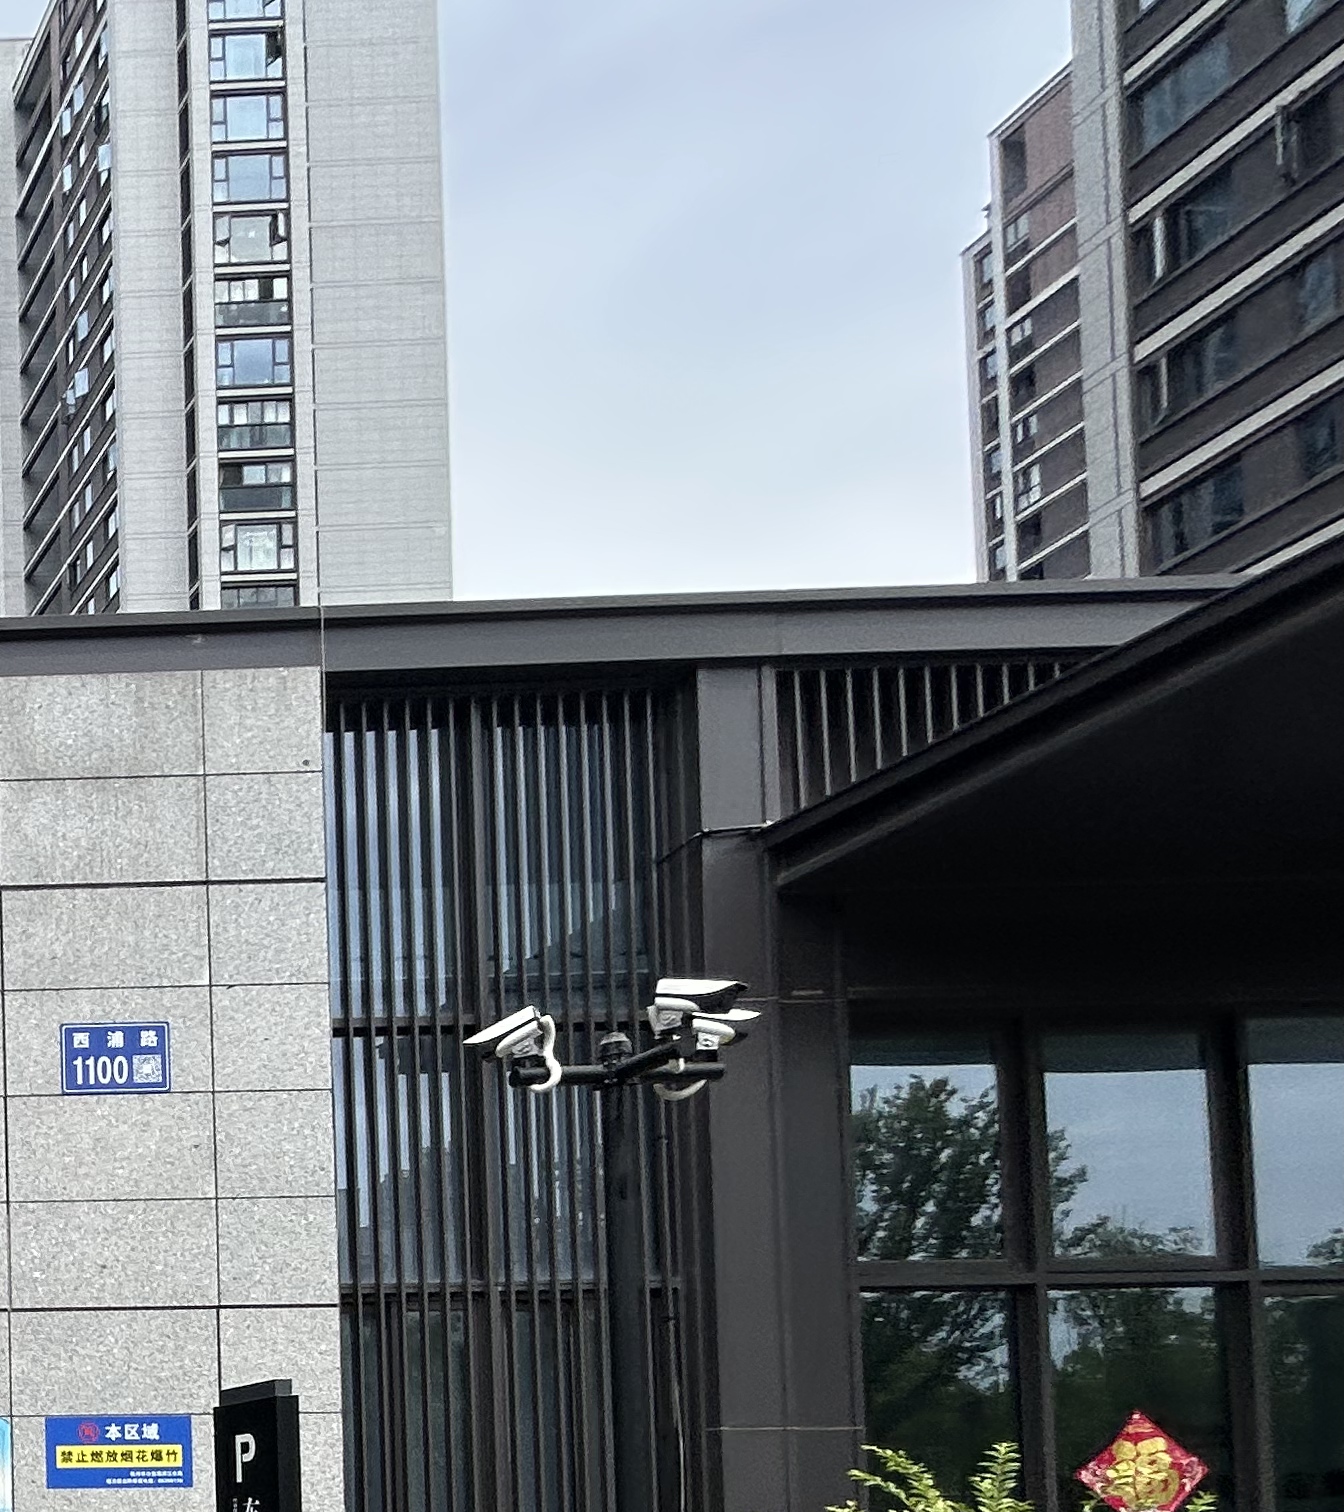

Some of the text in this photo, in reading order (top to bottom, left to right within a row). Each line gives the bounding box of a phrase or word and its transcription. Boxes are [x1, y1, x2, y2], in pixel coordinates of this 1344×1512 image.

[72, 1029, 158, 1048] 西浦路
[73, 1055, 129, 1085] 1100
[104, 1423, 160, 1441] 本区域
[60, 1450, 178, 1464] 禁止燃放烟花爆竹
[235, 1433, 256, 1483] P
